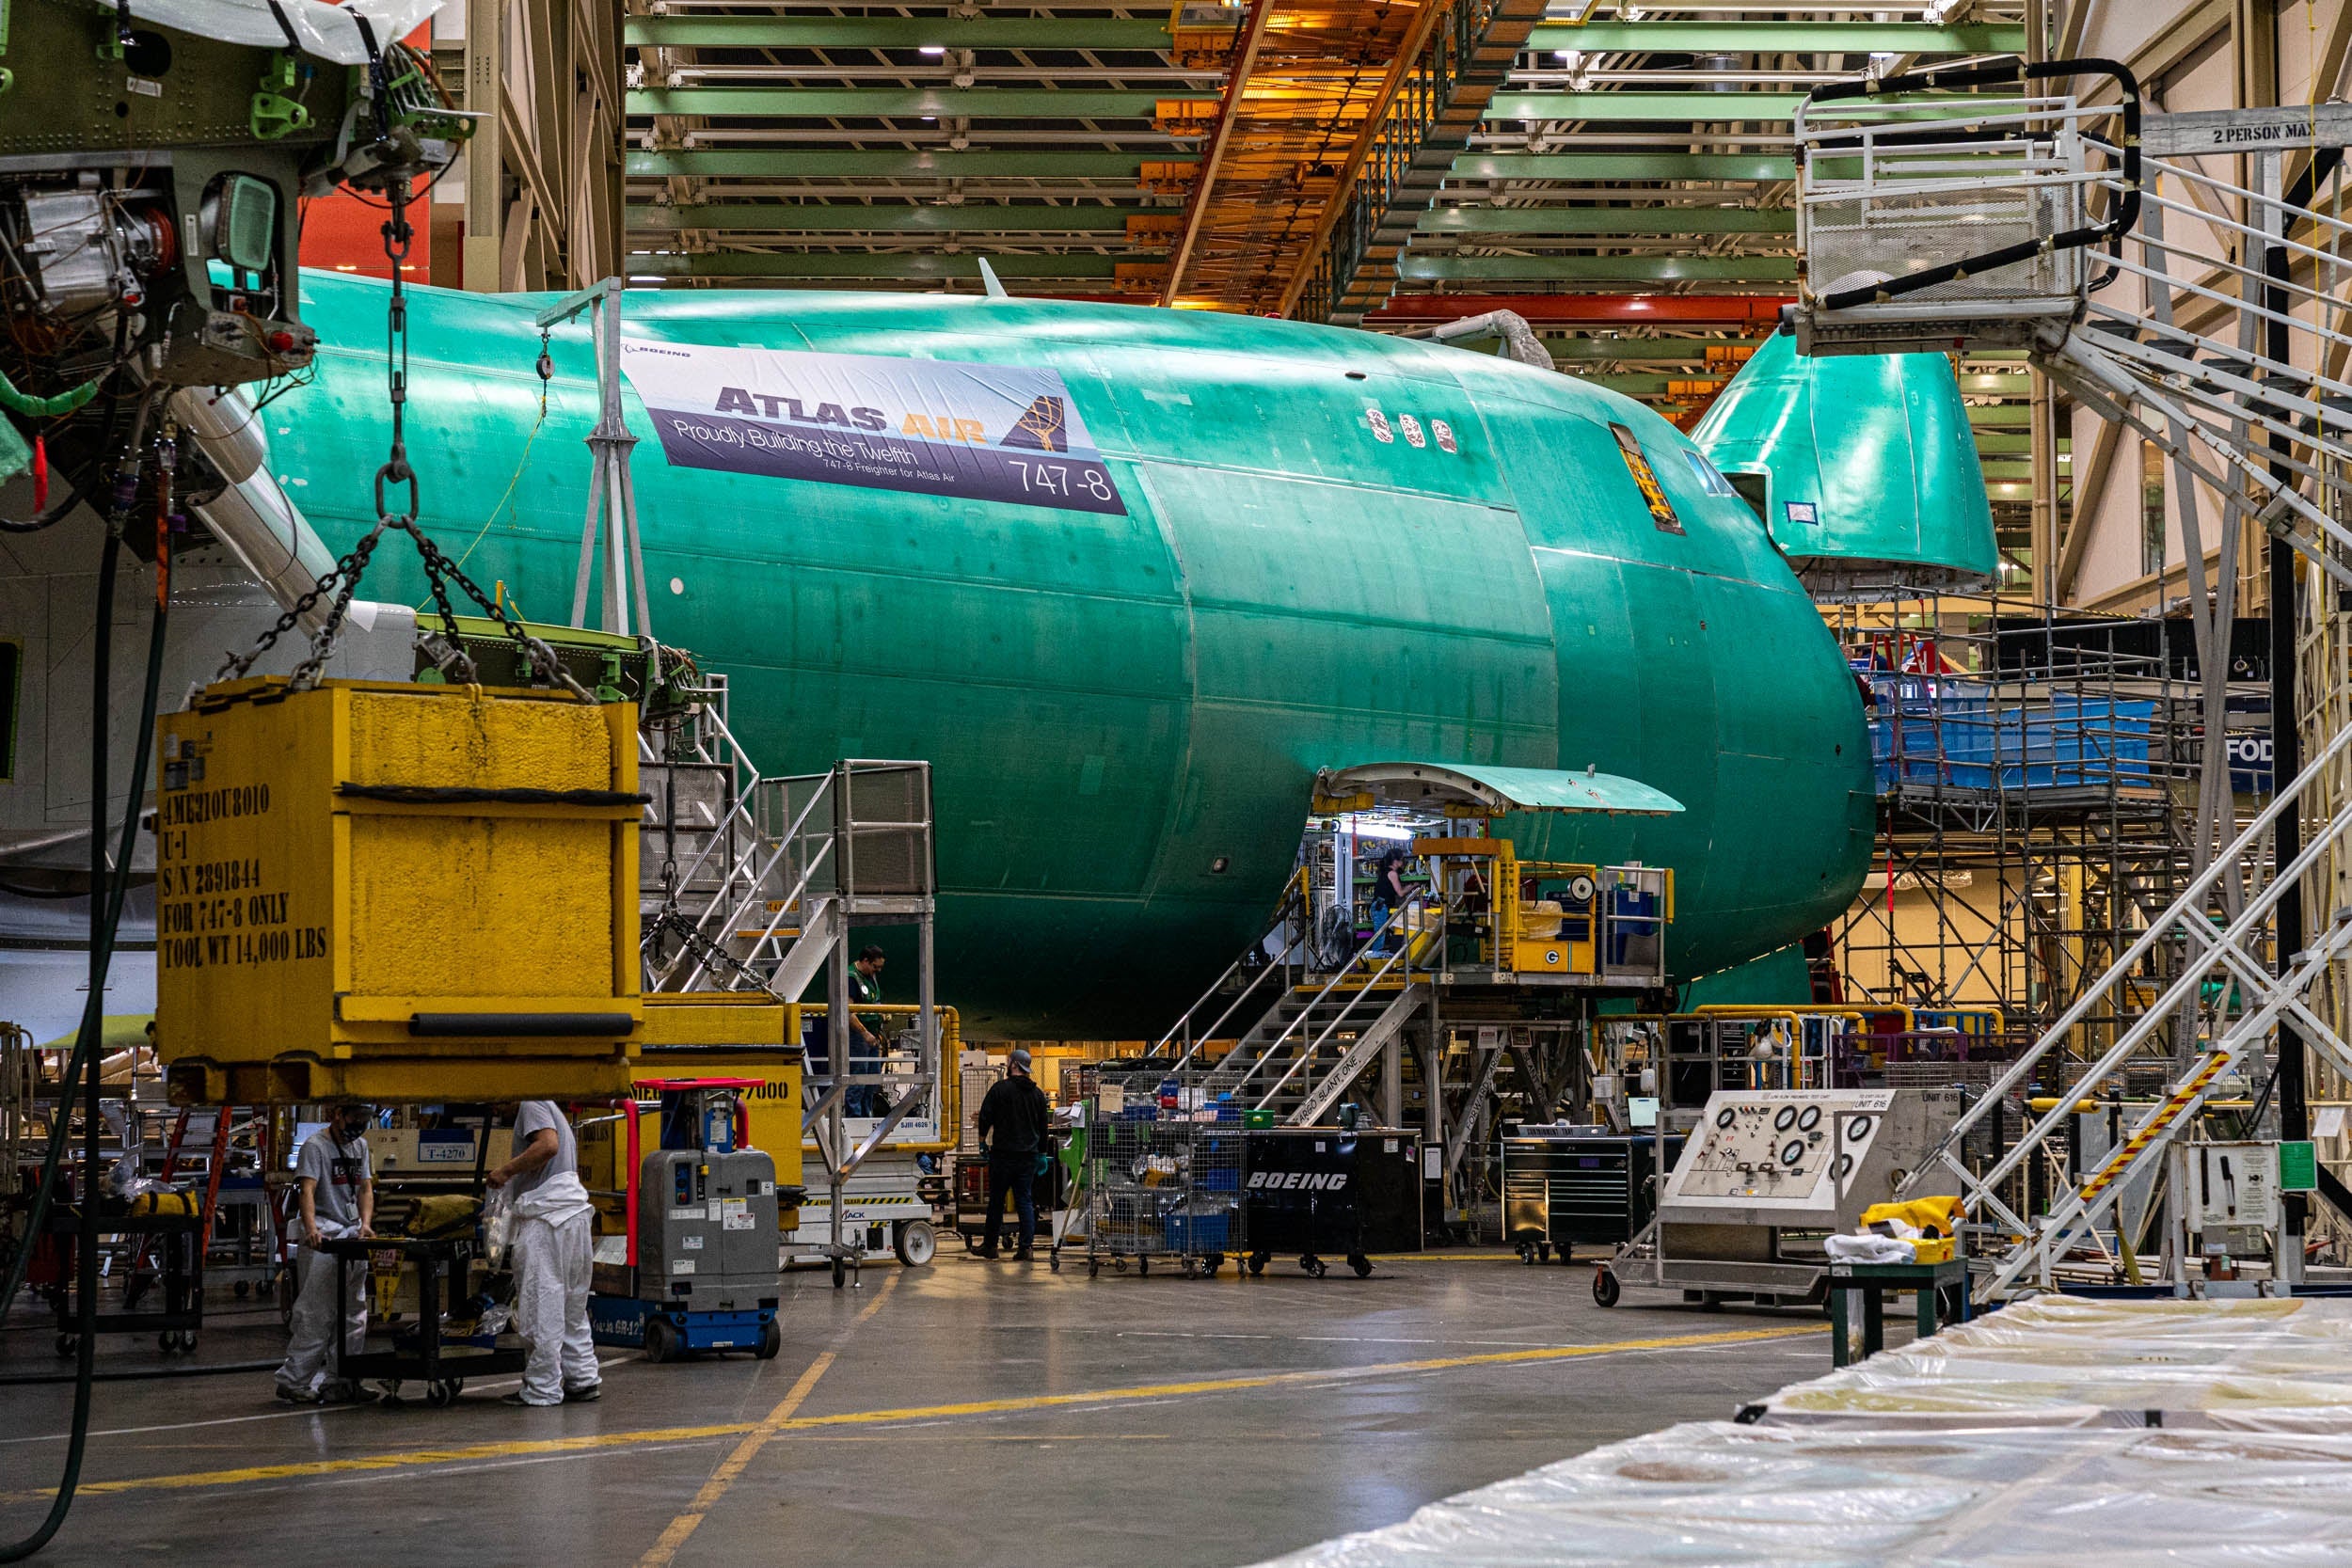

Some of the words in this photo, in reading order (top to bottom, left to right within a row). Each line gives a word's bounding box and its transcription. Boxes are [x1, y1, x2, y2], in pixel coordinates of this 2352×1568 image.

[2213, 129, 2223, 143] 2
[2226, 125, 2281, 142] PERSON
[2285, 122, 2316, 138] MAX
[639, 346, 691, 357] BOEING
[714, 386, 888, 432] ATLAS
[899, 413, 988, 444] AIR
[673, 420, 745, 448] Proudly
[747, 429, 823, 457] Building
[823, 438, 854, 457] the
[853, 441, 918, 465] Twelfth
[822, 458, 853, 471] 747-8
[855, 462, 901, 476] Freighter
[902, 467, 914, 478] for
[916, 469, 941, 481] Atlas
[943, 472, 955, 483] Air
[1008, 460, 1112, 501] 747-8
[163, 830, 187, 861] U-1
[195, 858, 261, 895] 2891844
[163, 902, 194, 933] FOR
[199, 897, 243, 931] 747-8
[248, 892, 290, 927] ONLY
[164, 936, 203, 969] TOOL
[206, 934, 230, 965] WT
[235, 929, 290, 970] 14,000
[294, 927, 326, 959] LBS
[1317, 1074, 1342, 1102] SLANT
[1342, 1054, 1359, 1076] ONE
[1465, 1082, 1491, 1132] FORWARD
[1854, 1100, 1872, 1108] UNIT
[1874, 1100, 1887, 1108] 616
[1922, 1094, 1941, 1102] UNIT
[1944, 1093, 1959, 1102] 616
[428, 1148, 466, 1159] T-4270
[1247, 1172, 1348, 1191] BOEING
